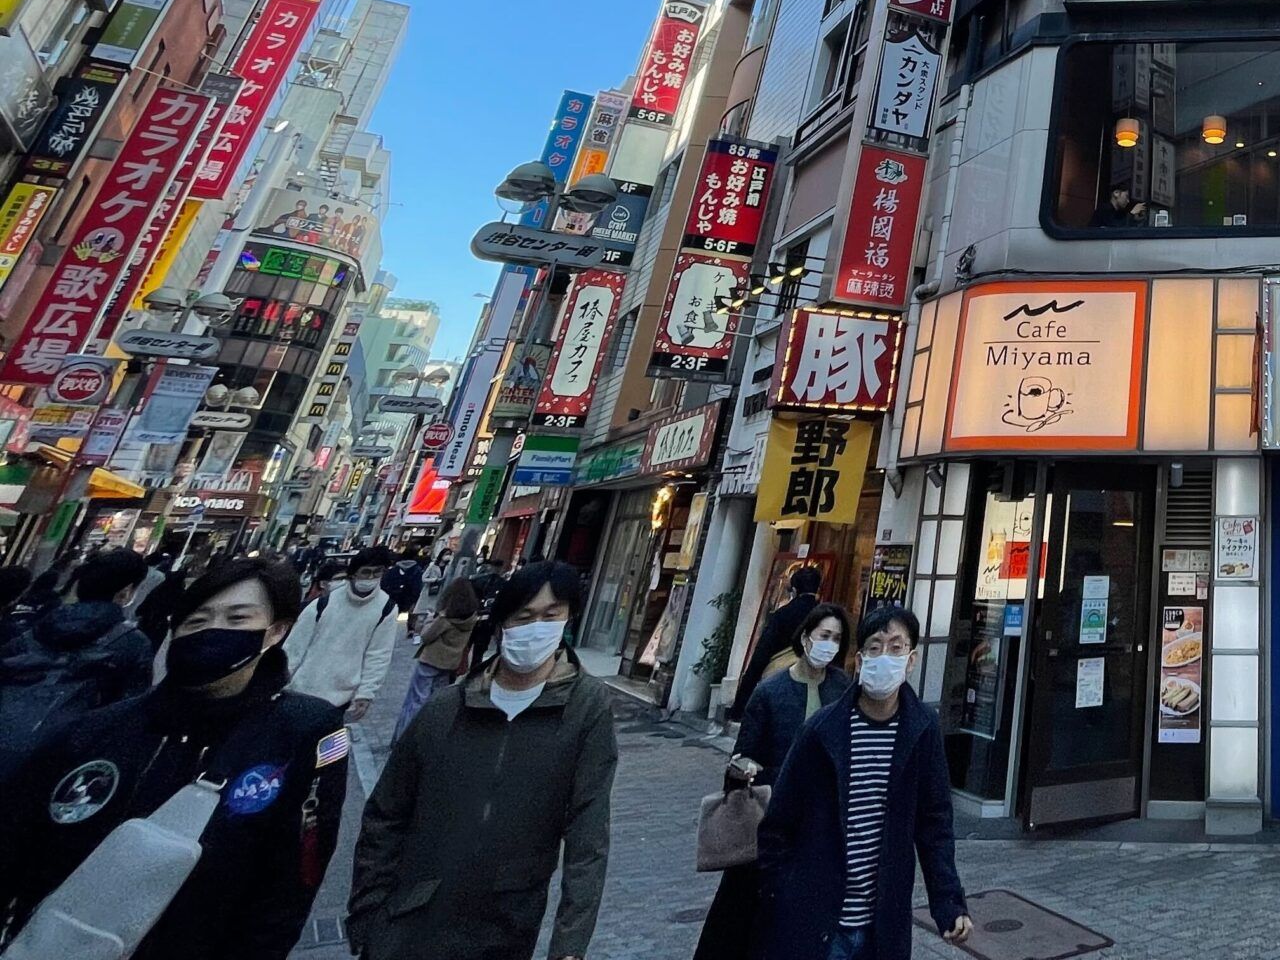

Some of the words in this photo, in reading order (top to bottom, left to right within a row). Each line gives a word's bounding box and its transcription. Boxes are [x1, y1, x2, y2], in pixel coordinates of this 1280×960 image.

[668, 4, 702, 20] 江戸前
[662, 28, 693, 89] お好み焼
[641, 49, 667, 104] もんじゃ
[892, 56, 918, 125] カンダヤ
[914, 61, 930, 110] 大衆スタンド
[548, 98, 584, 167] カラオケ
[592, 112, 614, 145] 麻雀
[33, 159, 65, 171] 3F
[101, 94, 198, 222] カラオケ
[728, 143, 760, 159] 85席
[620, 182, 638, 193] 4F
[695, 173, 721, 234] もんじゃ
[716, 159, 748, 226] お好み焼
[745, 167, 766, 207] 江戸前
[608, 221, 627, 232] Craft
[611, 229, 637, 242] MARKET
[484, 231, 600, 258] 渋谷センター街
[851, 269, 896, 280] マーラータン
[15, 263, 108, 375] 歌広場
[1017, 320, 1067, 339] Cafe
[565, 299, 603, 384] 椿屋カフェ
[985, 345, 1092, 370] Miyama
[790, 314, 889, 403] 豚
[60, 377, 101, 391] 消火栓
[458, 402, 476, 439] atmos
[446, 440, 463, 470] Heart
[531, 454, 571, 463] FamilyMart
[781, 421, 848, 517] 野郎
[233, 778, 282, 800] NASA
